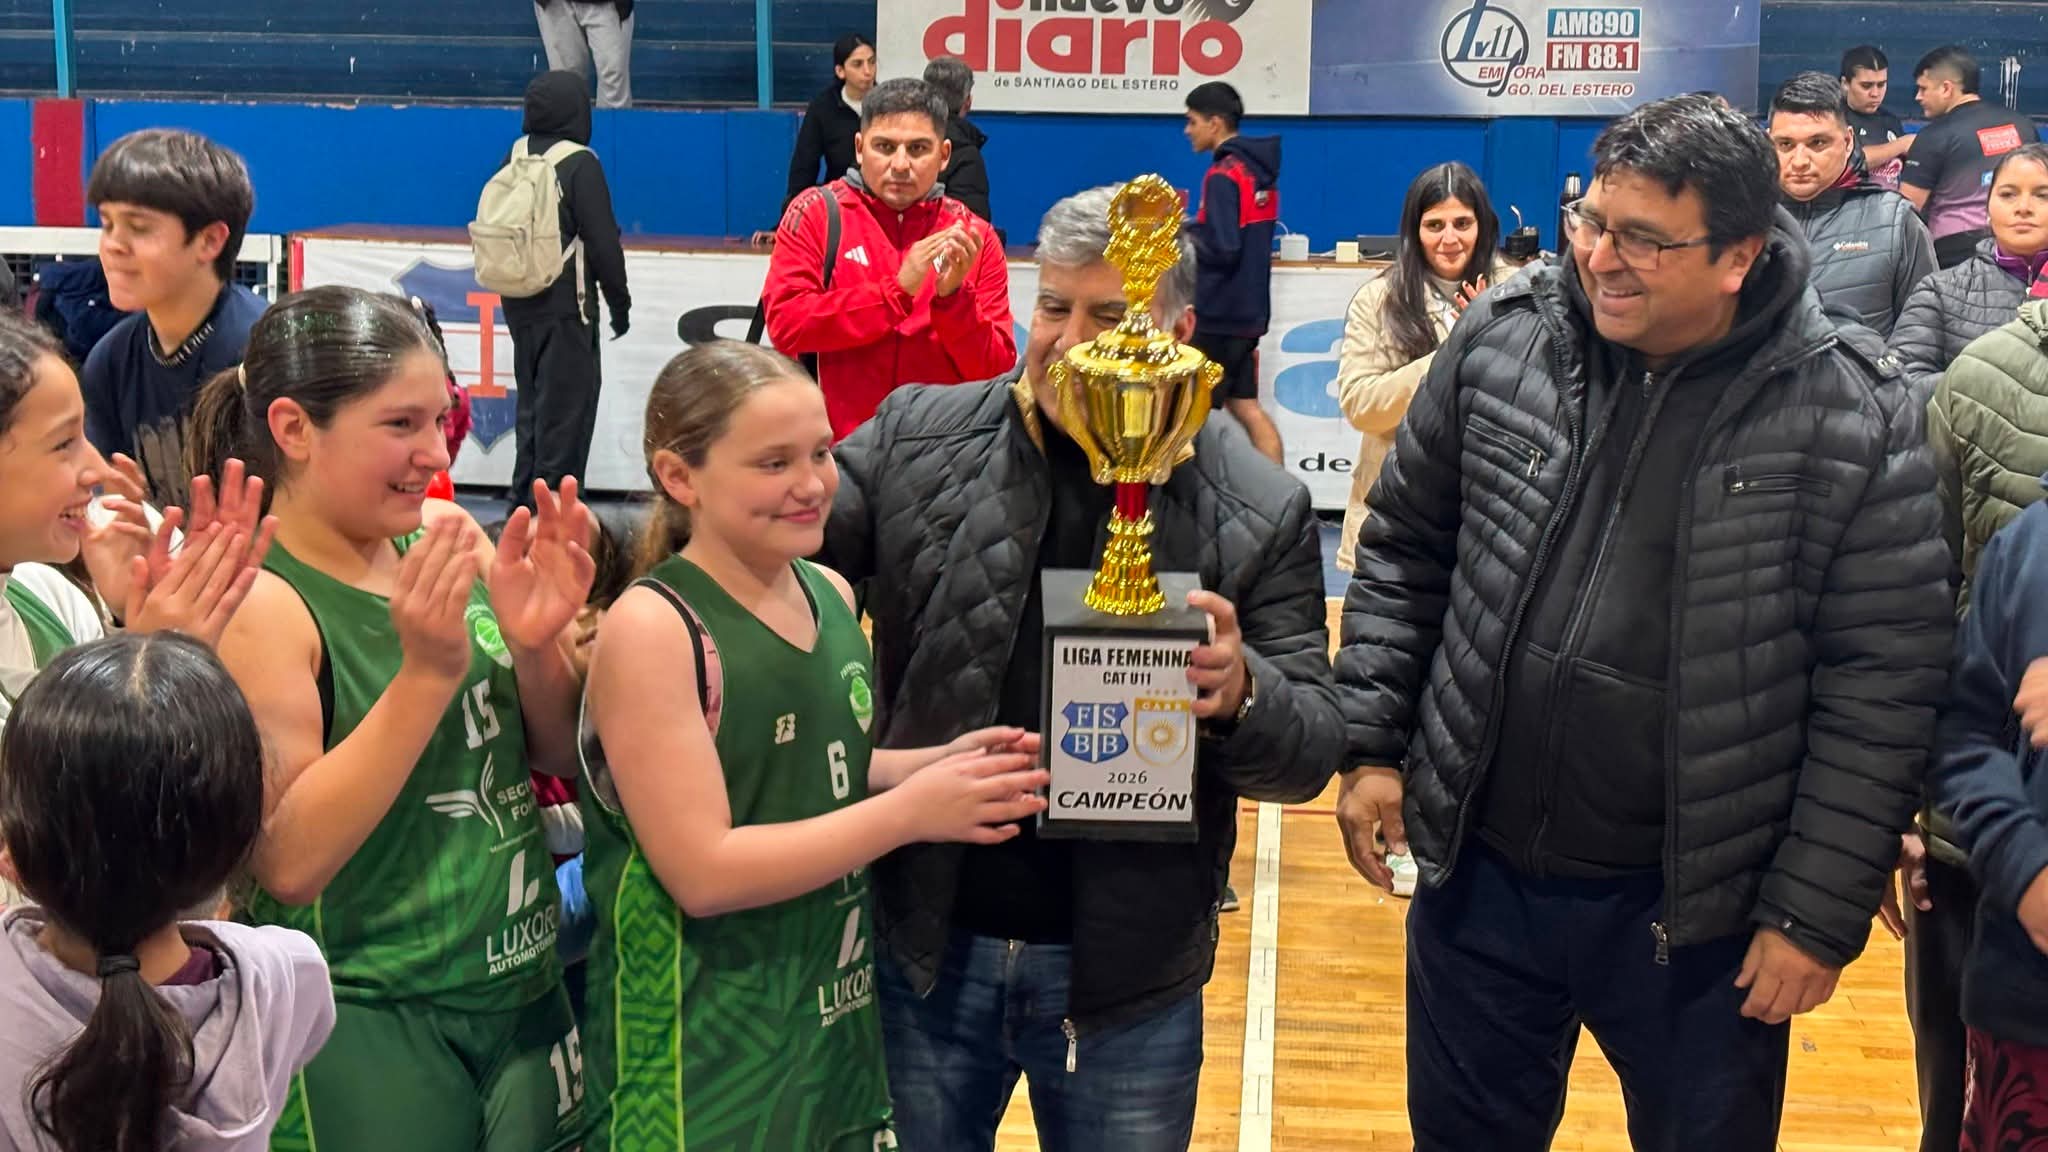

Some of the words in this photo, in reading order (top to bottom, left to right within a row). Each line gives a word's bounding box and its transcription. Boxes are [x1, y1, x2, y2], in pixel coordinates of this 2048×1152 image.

[1552, 10, 1635, 36] AM890
[922, 0, 1243, 76] diario
[1551, 44, 1585, 69] FM
[1588, 44, 1635, 70] 88.1
[994, 78, 1010, 88] de
[1014, 77, 1087, 89] SANTIAGO
[1091, 78, 1118, 89] DEL
[1122, 79, 1179, 91] ESTERO
[1538, 83, 1568, 97] DEL
[1572, 83, 1634, 97] ESTERO
[1299, 452, 1352, 473] de
[1063, 647, 1101, 665] LIGA
[1107, 648, 1193, 668] FEMENINA
[1103, 671, 1127, 685] CAT
[1130, 672, 1151, 685] U11
[462, 678, 500, 750] 15
[827, 739, 850, 800] 6
[1107, 771, 1148, 784] 2026
[1057, 787, 1187, 811] CAMPEÓN
[486, 904, 555, 963] LUXOR
[818, 963, 872, 1015] LUXOR
